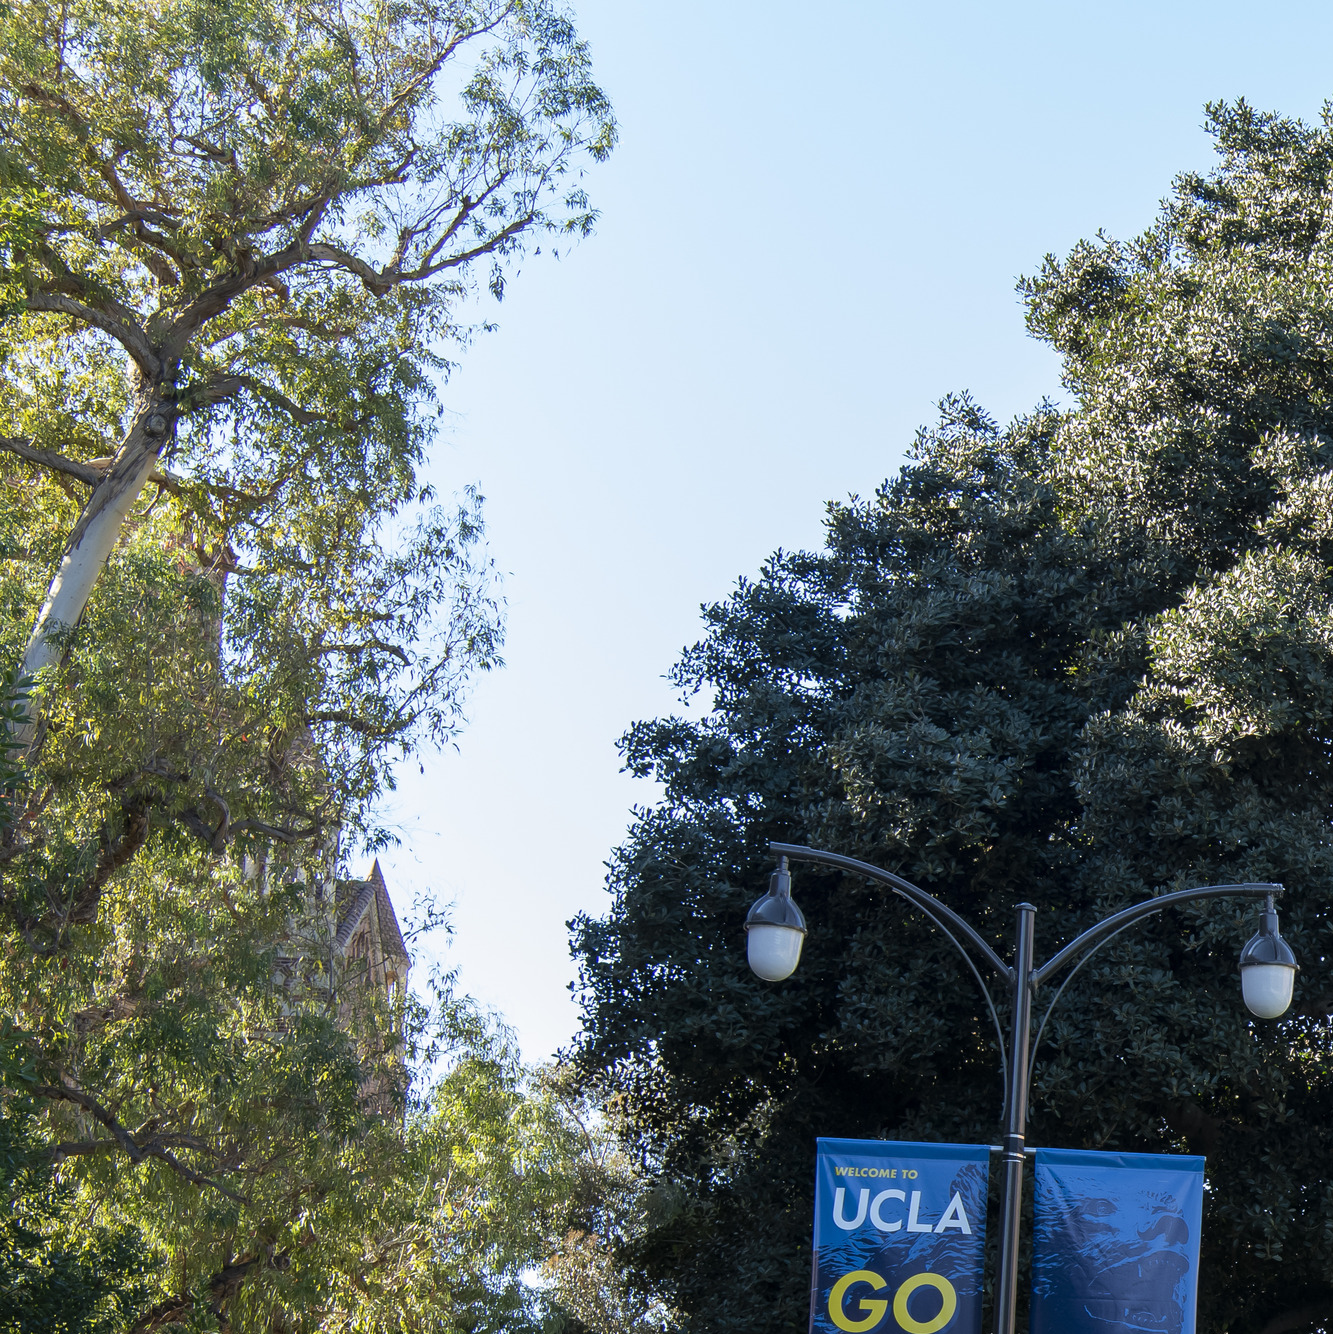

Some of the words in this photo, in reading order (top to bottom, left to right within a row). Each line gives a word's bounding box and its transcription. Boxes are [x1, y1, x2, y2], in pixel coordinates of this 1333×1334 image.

[835, 1166, 897, 1179] WELCOME
[902, 1169, 918, 1180] TO
[832, 1187, 972, 1235] UCLA
[828, 1270, 957, 1334] GO
